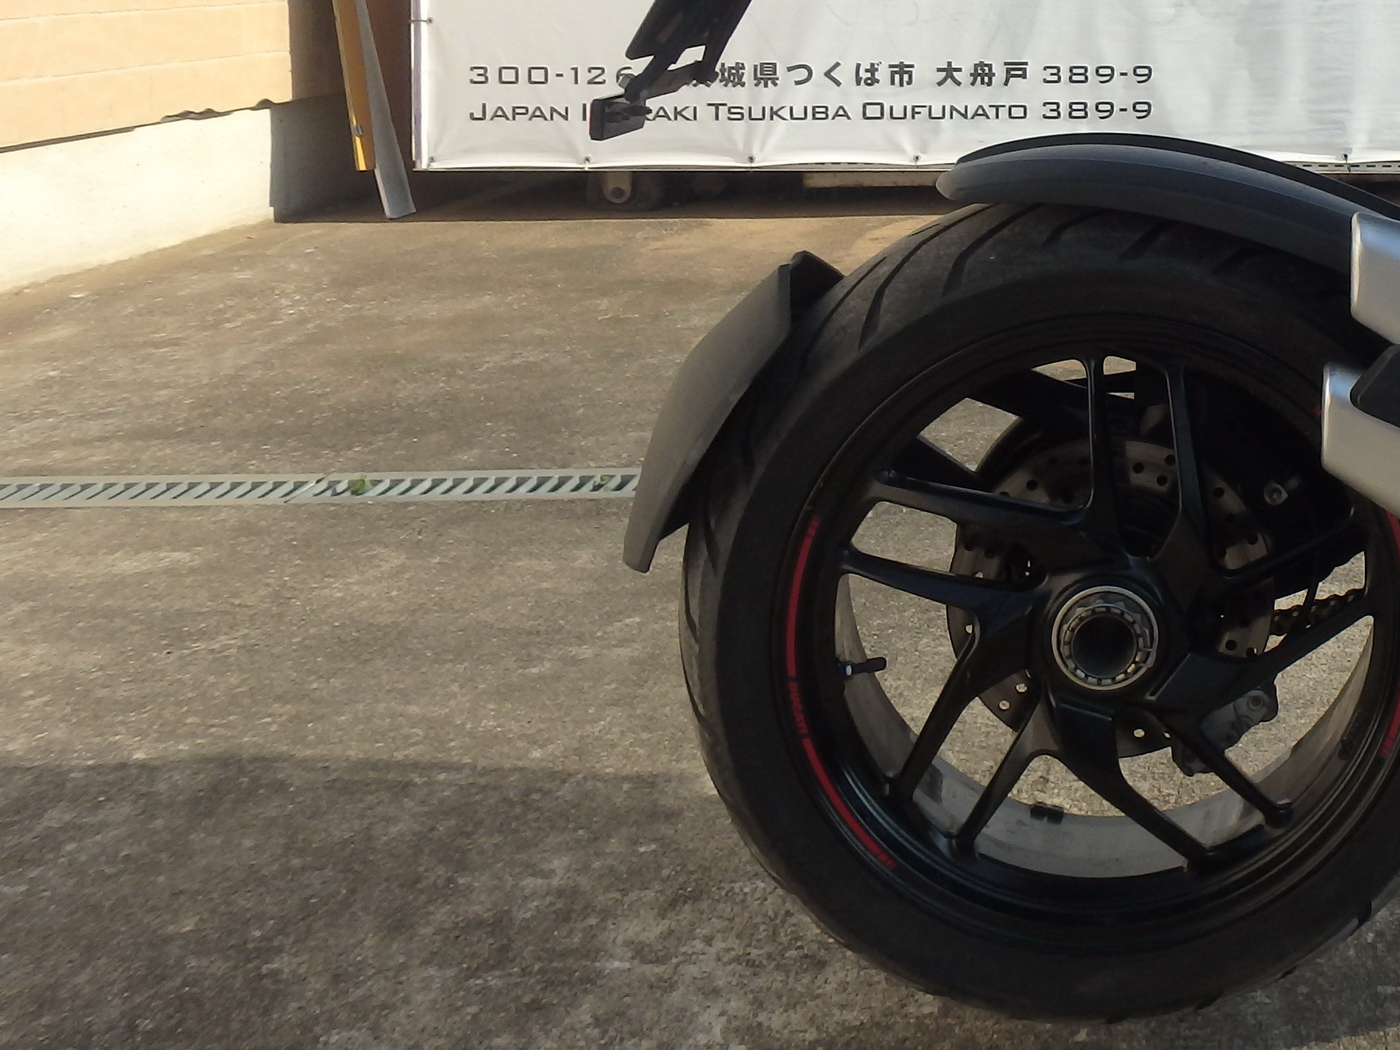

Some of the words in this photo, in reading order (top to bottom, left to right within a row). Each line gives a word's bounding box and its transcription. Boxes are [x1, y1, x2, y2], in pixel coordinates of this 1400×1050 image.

[686, 60, 915, 89] 城県つくば市
[935, 60, 1029, 87] 大舟戸
[1042, 65, 1154, 84] 389-9
[469, 103, 569, 122] JAPAN
[582, 103, 698, 122] IAKI
[706, 102, 852, 122] TSUKUBA
[861, 101, 1028, 120] OUFUNATO
[1042, 101, 1154, 120] 389-9
[787, 680, 809, 734] DUCATI
